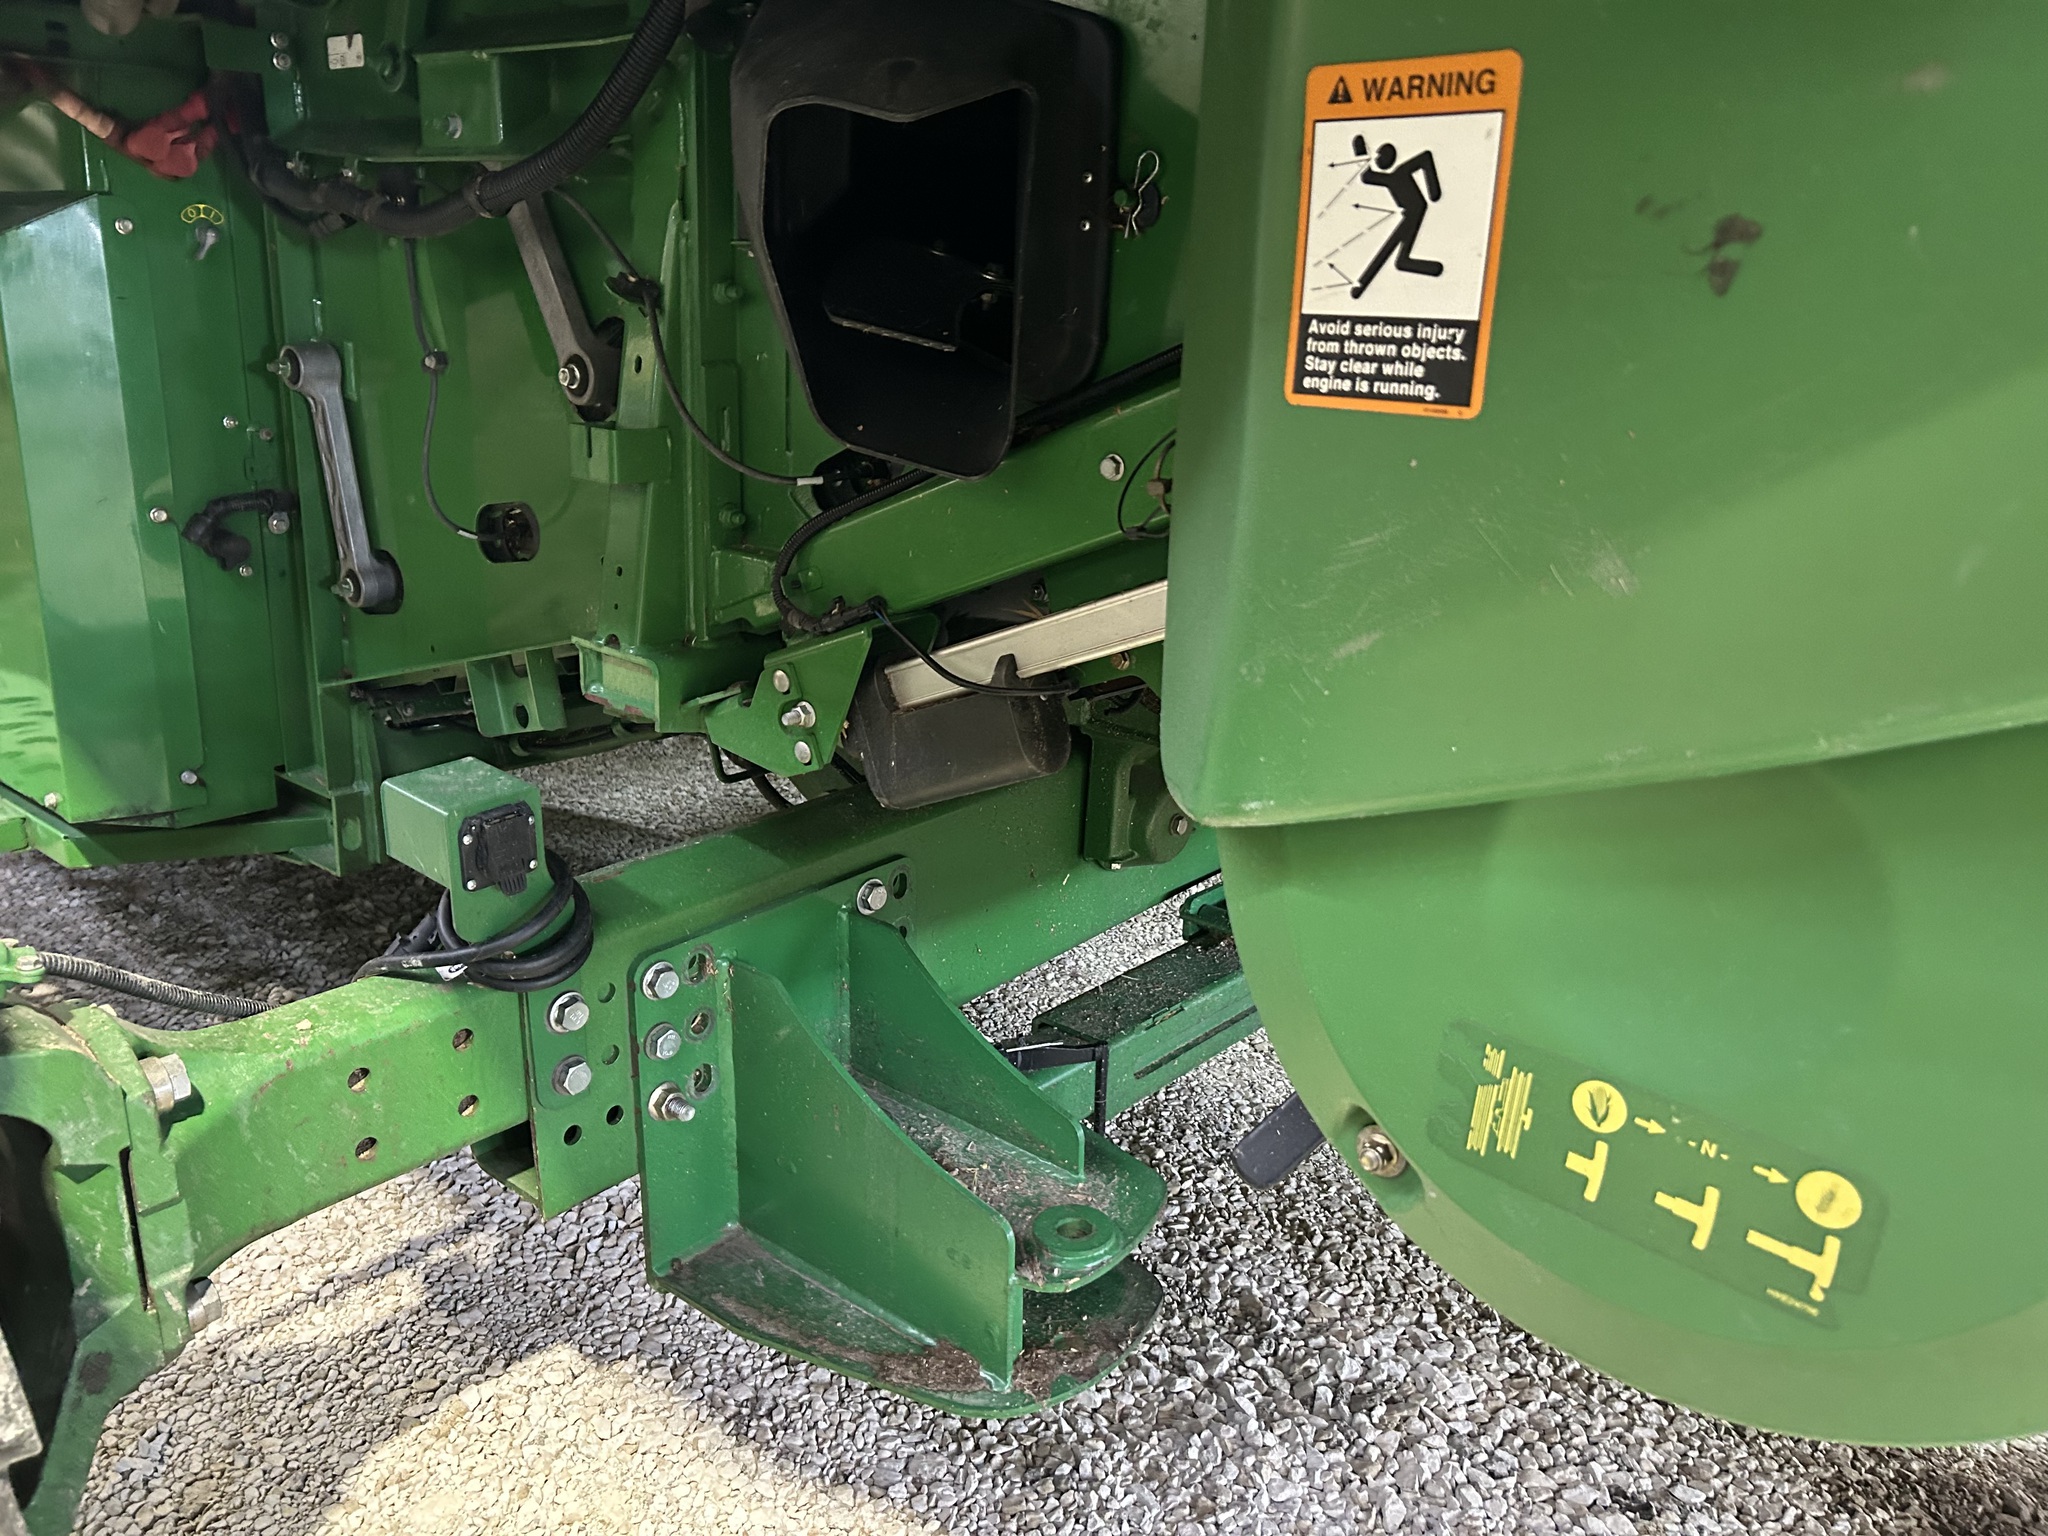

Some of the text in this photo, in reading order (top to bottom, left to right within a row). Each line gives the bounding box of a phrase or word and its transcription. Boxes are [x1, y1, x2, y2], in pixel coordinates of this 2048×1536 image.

[1362, 68, 1496, 102] WARNING
[1308, 318, 1467, 345] Avoid serious injury
[1306, 336, 1467, 362] from thrown objects.
[1304, 355, 1426, 379] Stay clear while
[1302, 375, 1441, 401] engine is running.
